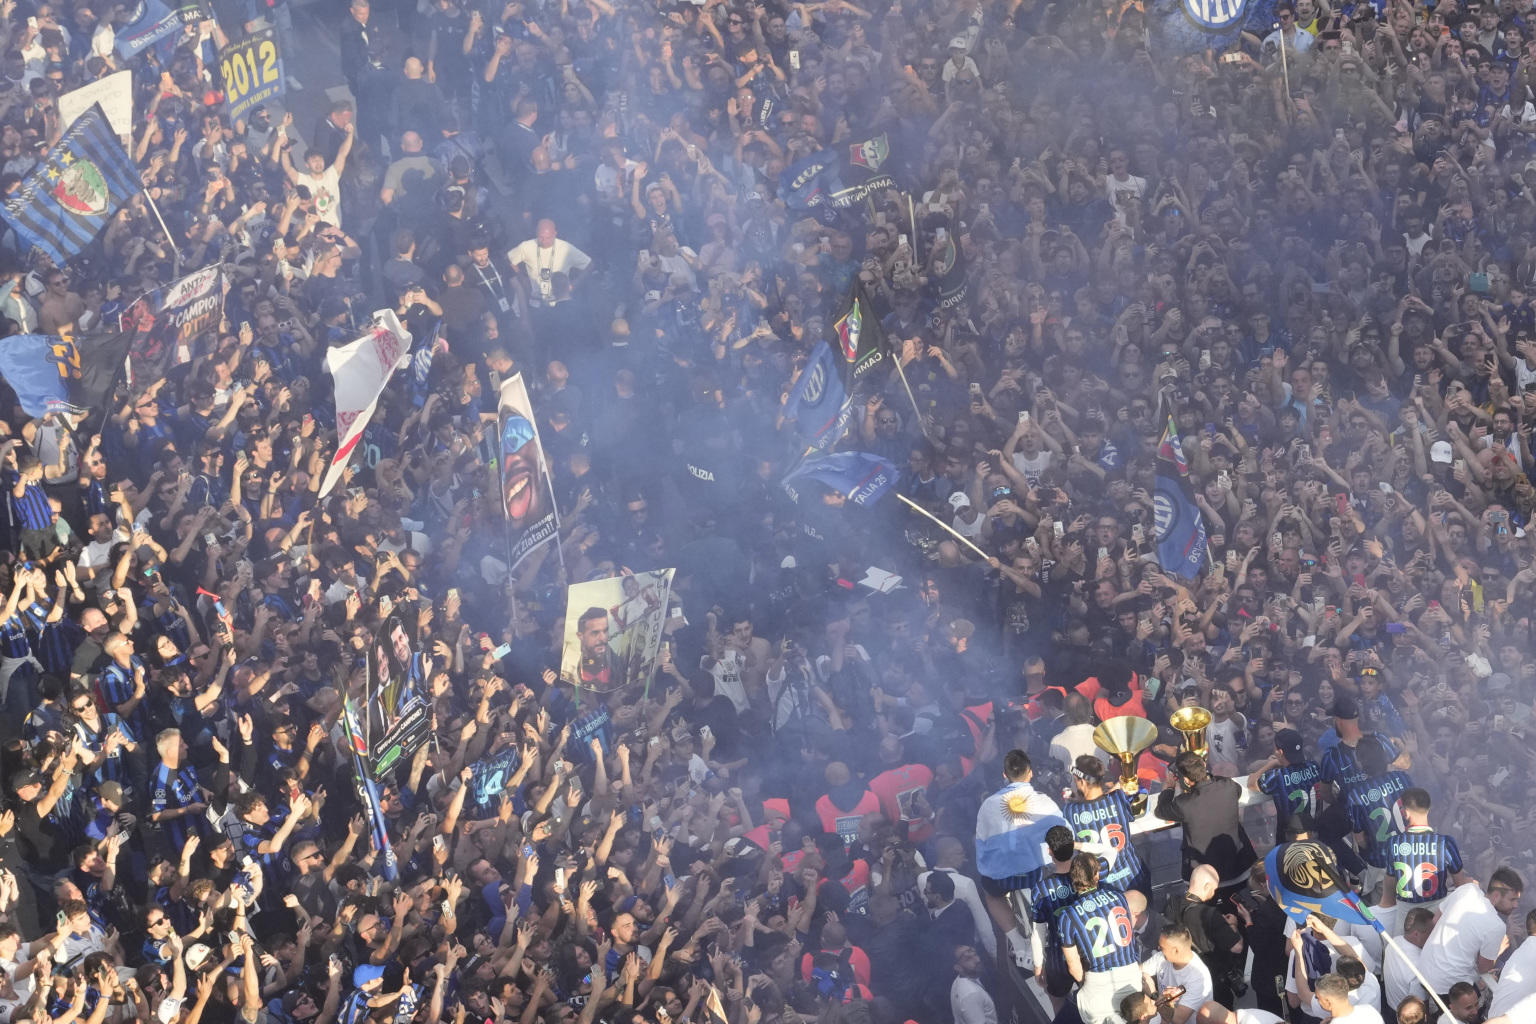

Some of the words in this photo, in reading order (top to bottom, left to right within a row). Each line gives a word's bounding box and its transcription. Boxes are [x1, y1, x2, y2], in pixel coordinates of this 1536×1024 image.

[221, 41, 279, 104] 2012
[1073, 804, 1118, 825] DOUBLE
[1393, 841, 1437, 856] DOUBLE
[1393, 861, 1439, 899] 26
[1075, 890, 1120, 917] DOUBLE
[1085, 905, 1133, 959] 26
